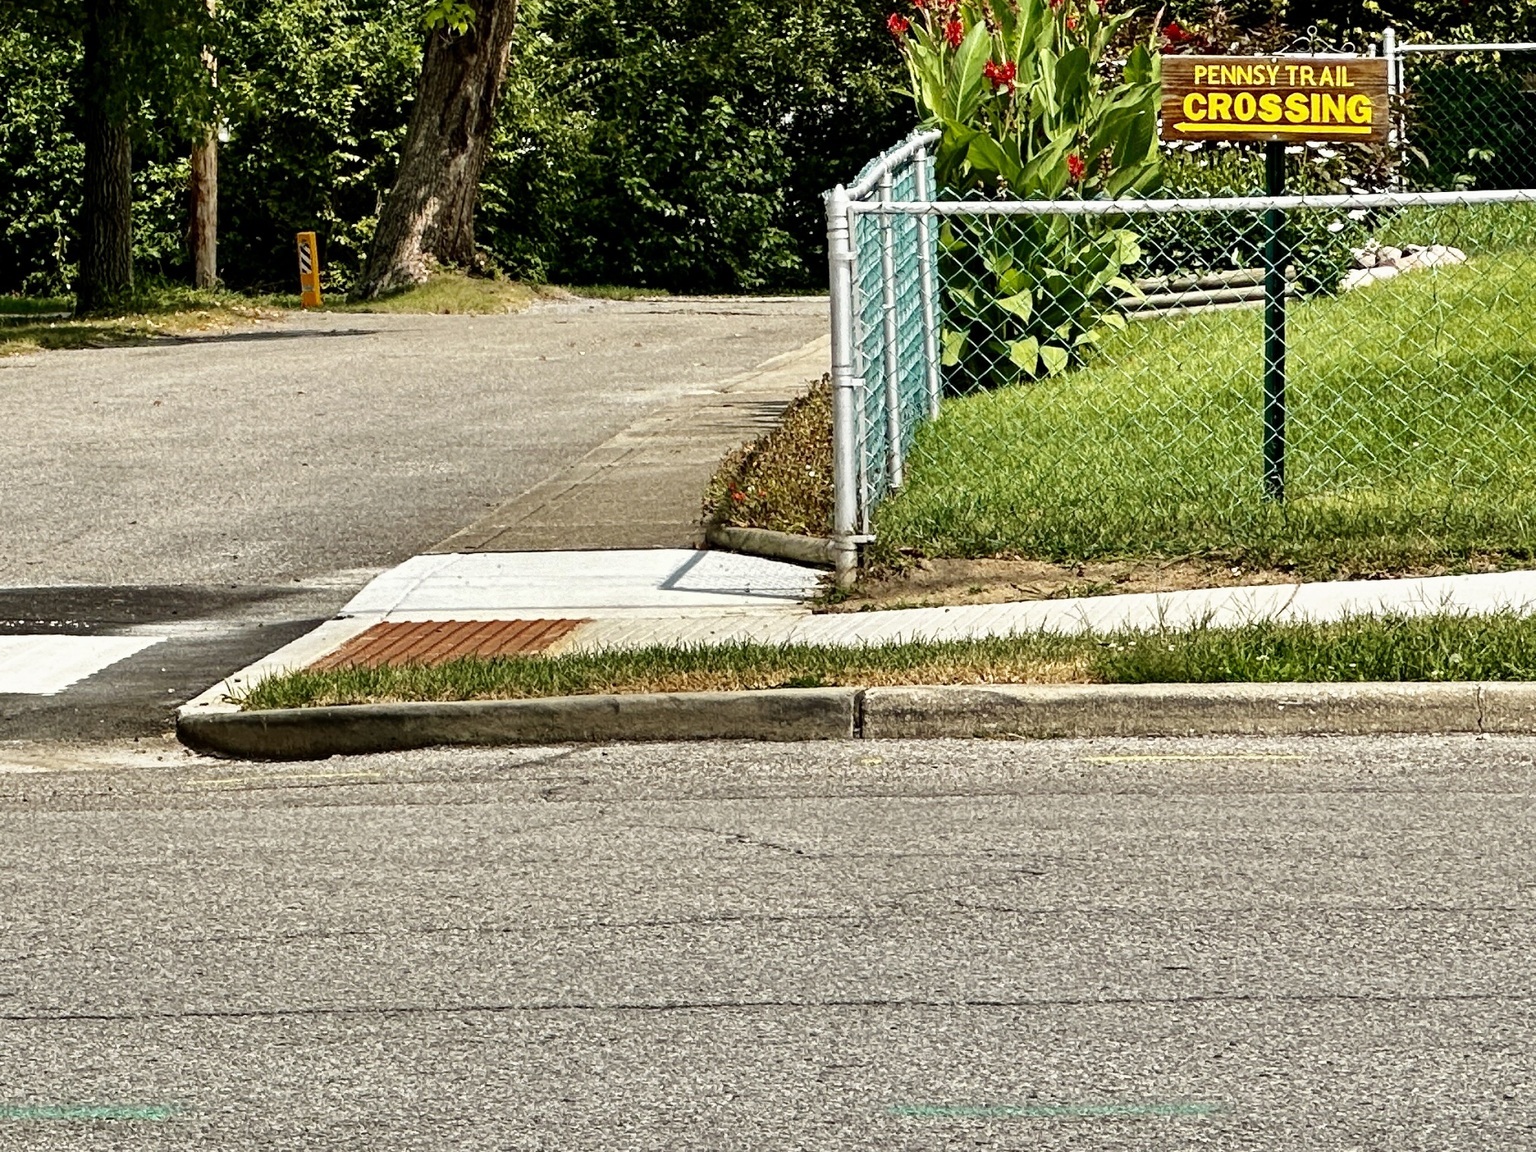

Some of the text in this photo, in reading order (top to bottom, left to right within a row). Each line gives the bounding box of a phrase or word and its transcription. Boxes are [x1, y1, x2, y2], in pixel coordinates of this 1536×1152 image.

[1194, 64, 1355, 87] PENNSY TRAIL
[1183, 91, 1372, 124] CROSSING
